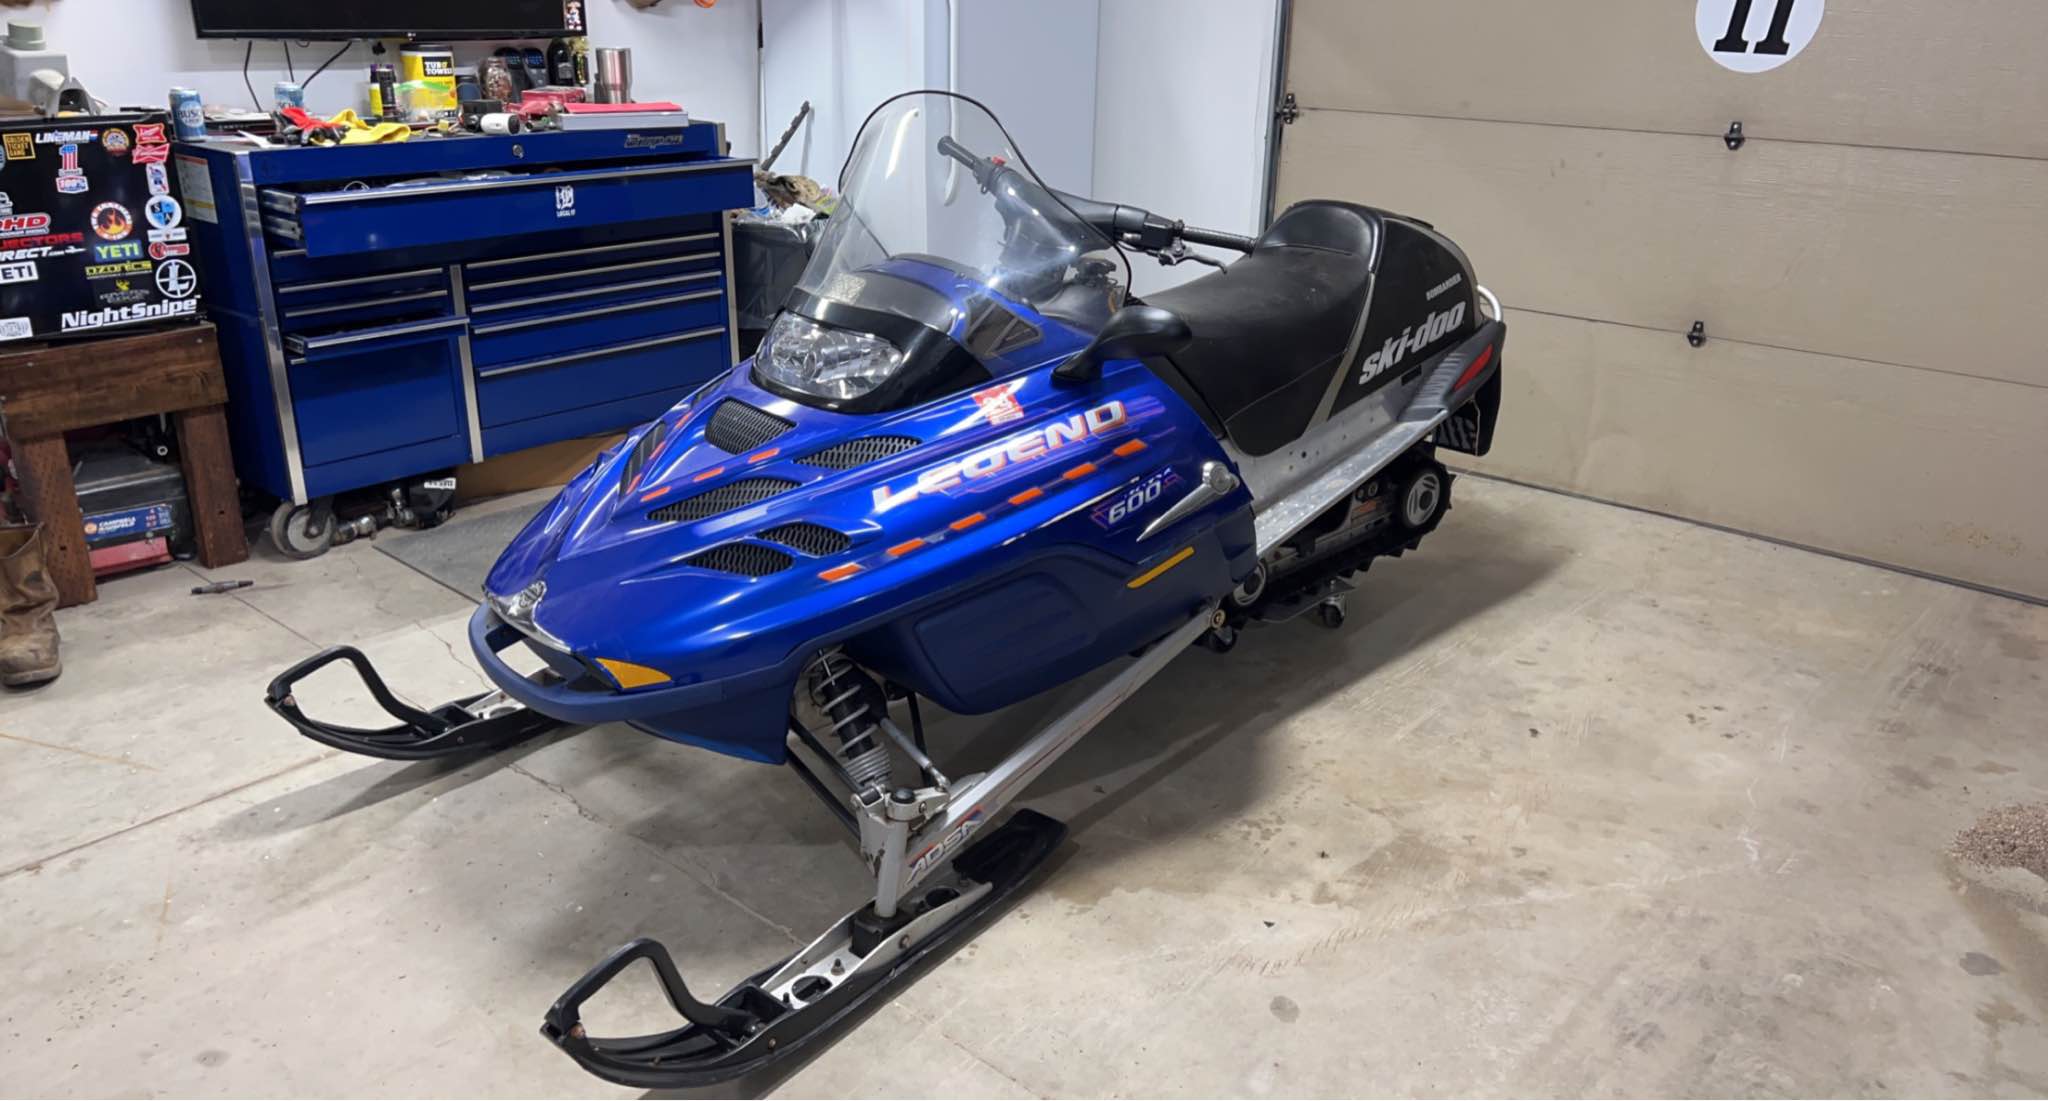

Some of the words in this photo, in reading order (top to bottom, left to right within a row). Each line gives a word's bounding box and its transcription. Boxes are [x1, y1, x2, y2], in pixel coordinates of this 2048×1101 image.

[0, 214, 48, 232] HD
[96, 242, 140, 259] YETI
[61, 299, 197, 329] NightSnipe
[1359, 302, 1466, 385] ski-doo
[872, 400, 1128, 515] LEGEND
[1109, 480, 1161, 524] 600
